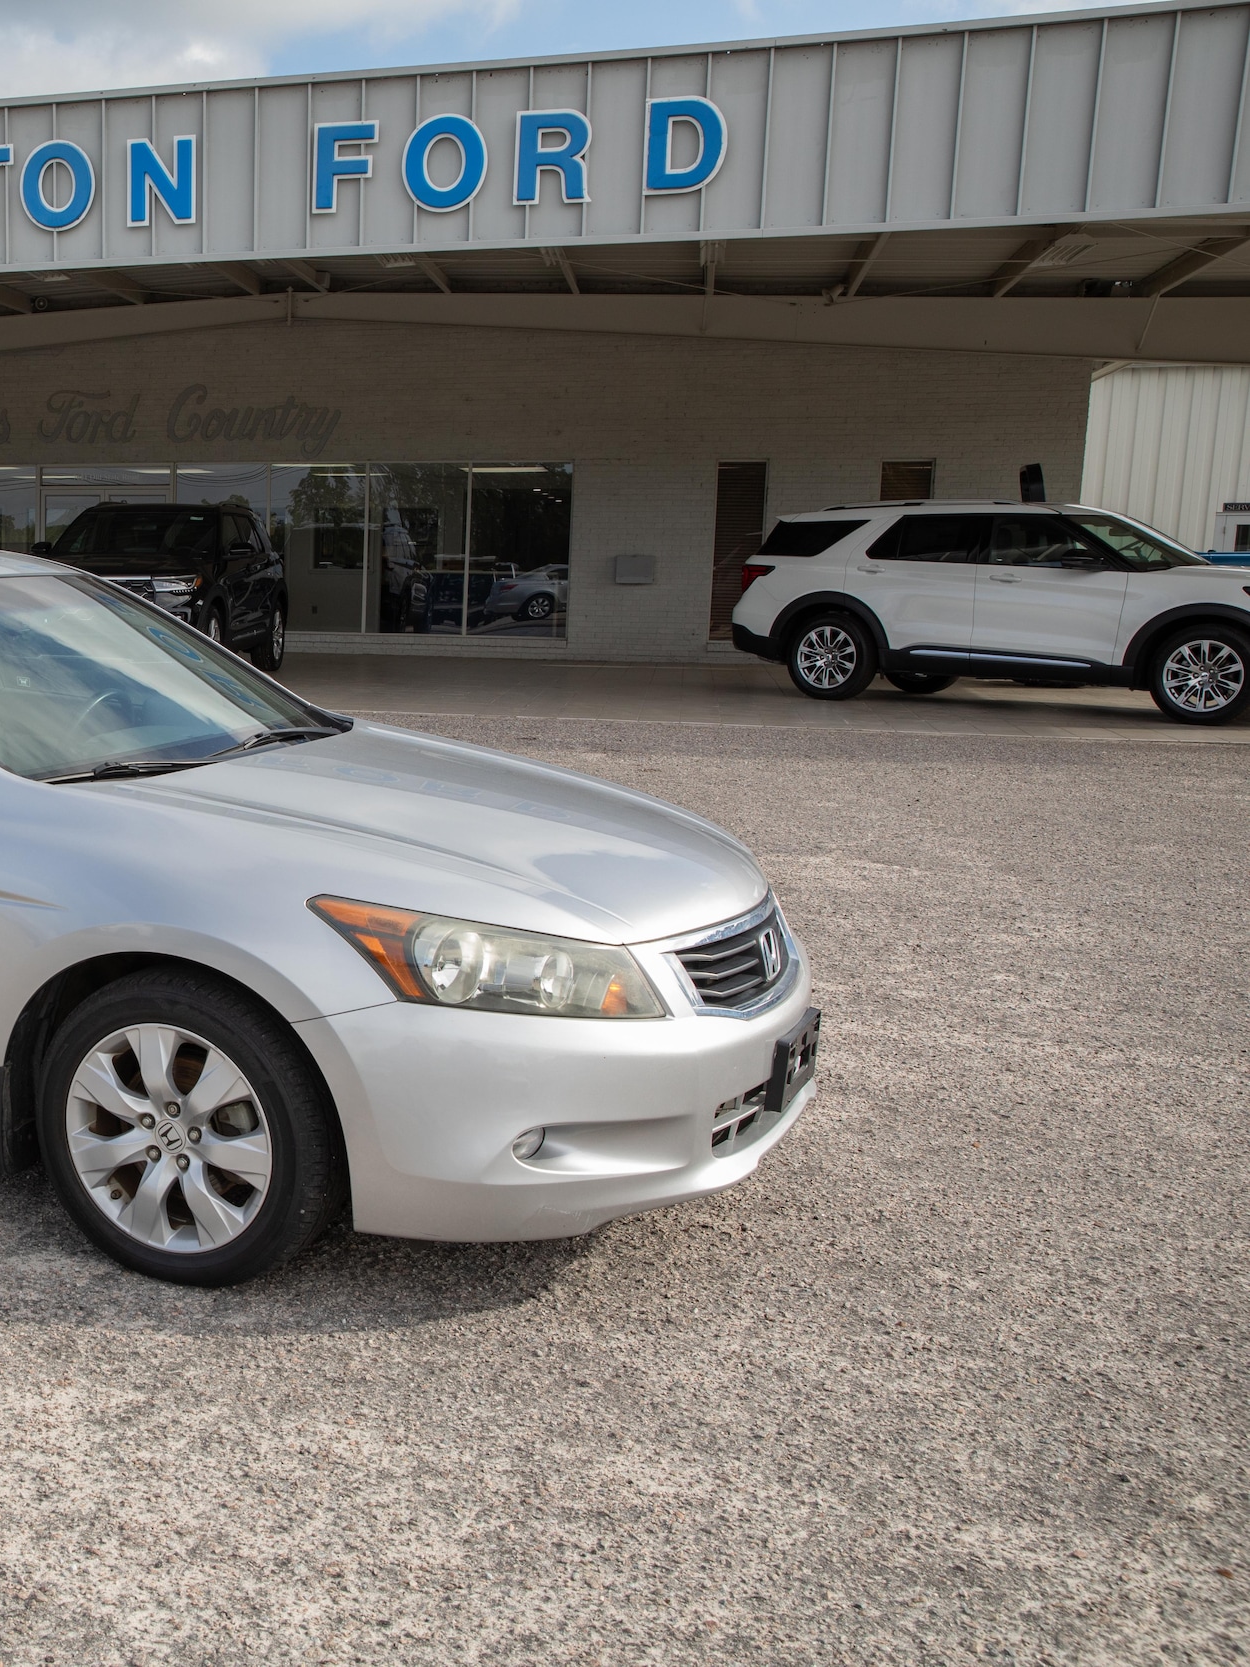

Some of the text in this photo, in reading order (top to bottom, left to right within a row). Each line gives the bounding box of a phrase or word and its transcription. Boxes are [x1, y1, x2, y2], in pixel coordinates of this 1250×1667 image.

[311, 95, 729, 214] FORD
[37, 390, 141, 444] Ford
[166, 383, 342, 460] Country
